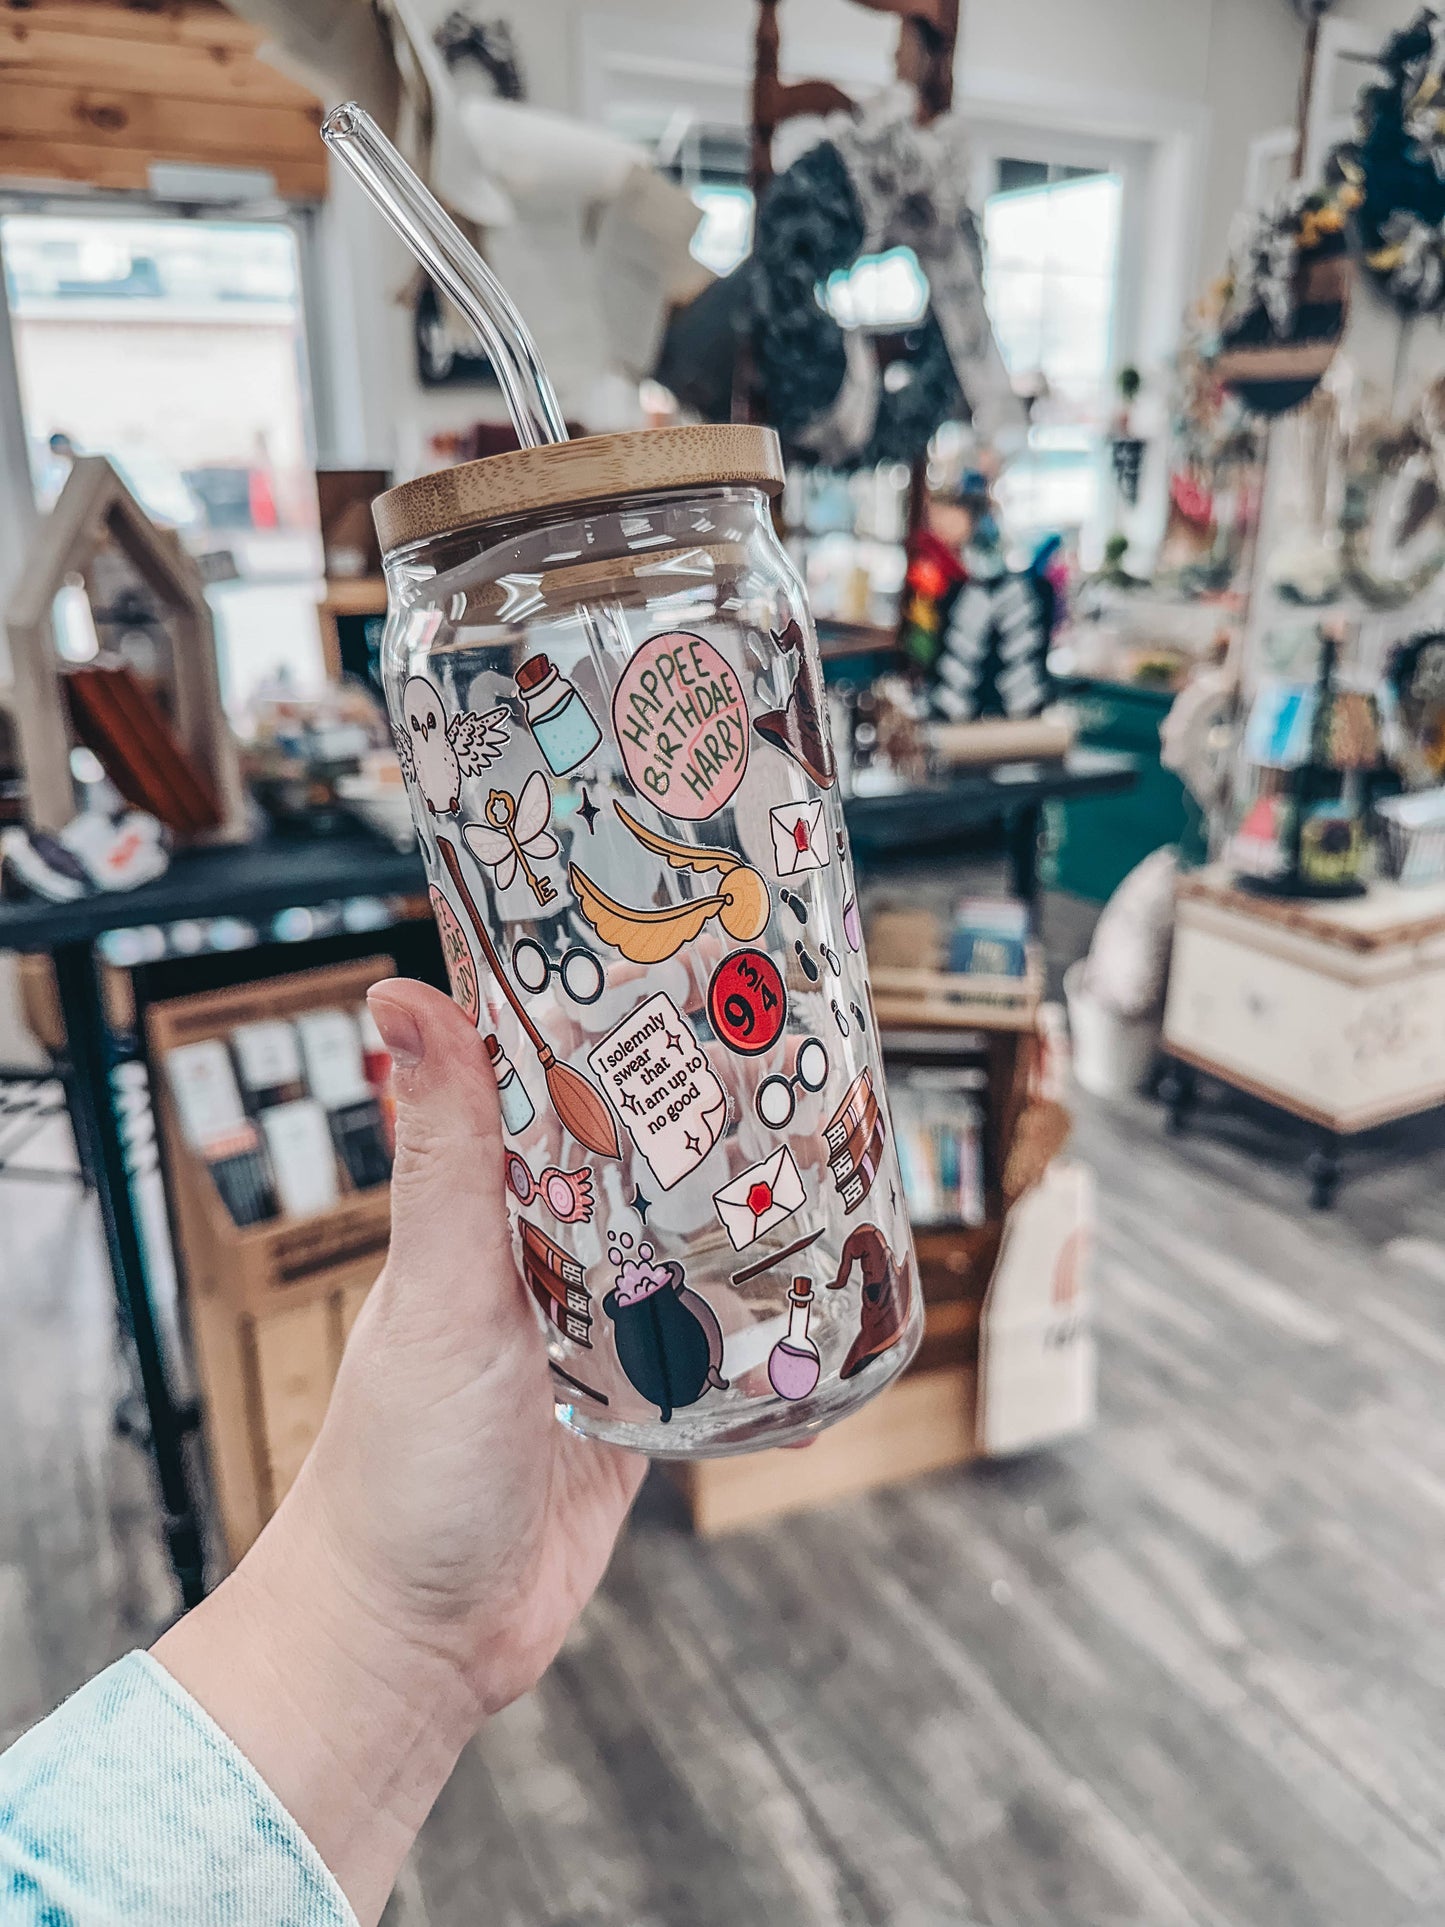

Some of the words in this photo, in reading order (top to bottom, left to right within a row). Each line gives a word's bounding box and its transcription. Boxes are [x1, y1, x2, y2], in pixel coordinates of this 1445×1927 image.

[622, 641, 710, 752] HAPPEE
[644, 671, 738, 796] BIRTHDAE
[681, 707, 746, 801] HARRY
[598, 1057, 609, 1073] I
[607, 1012, 666, 1068] solemnly
[723, 993, 755, 1037] 9
[613, 1048, 652, 1087] swear
[636, 1100, 647, 1116] I
[645, 1088, 671, 1110] am
[672, 1070, 687, 1090] up
[685, 1056, 702, 1074] to
[640, 1056, 671, 1086] that
[647, 1114, 667, 1135] no
[666, 1081, 701, 1123] good
